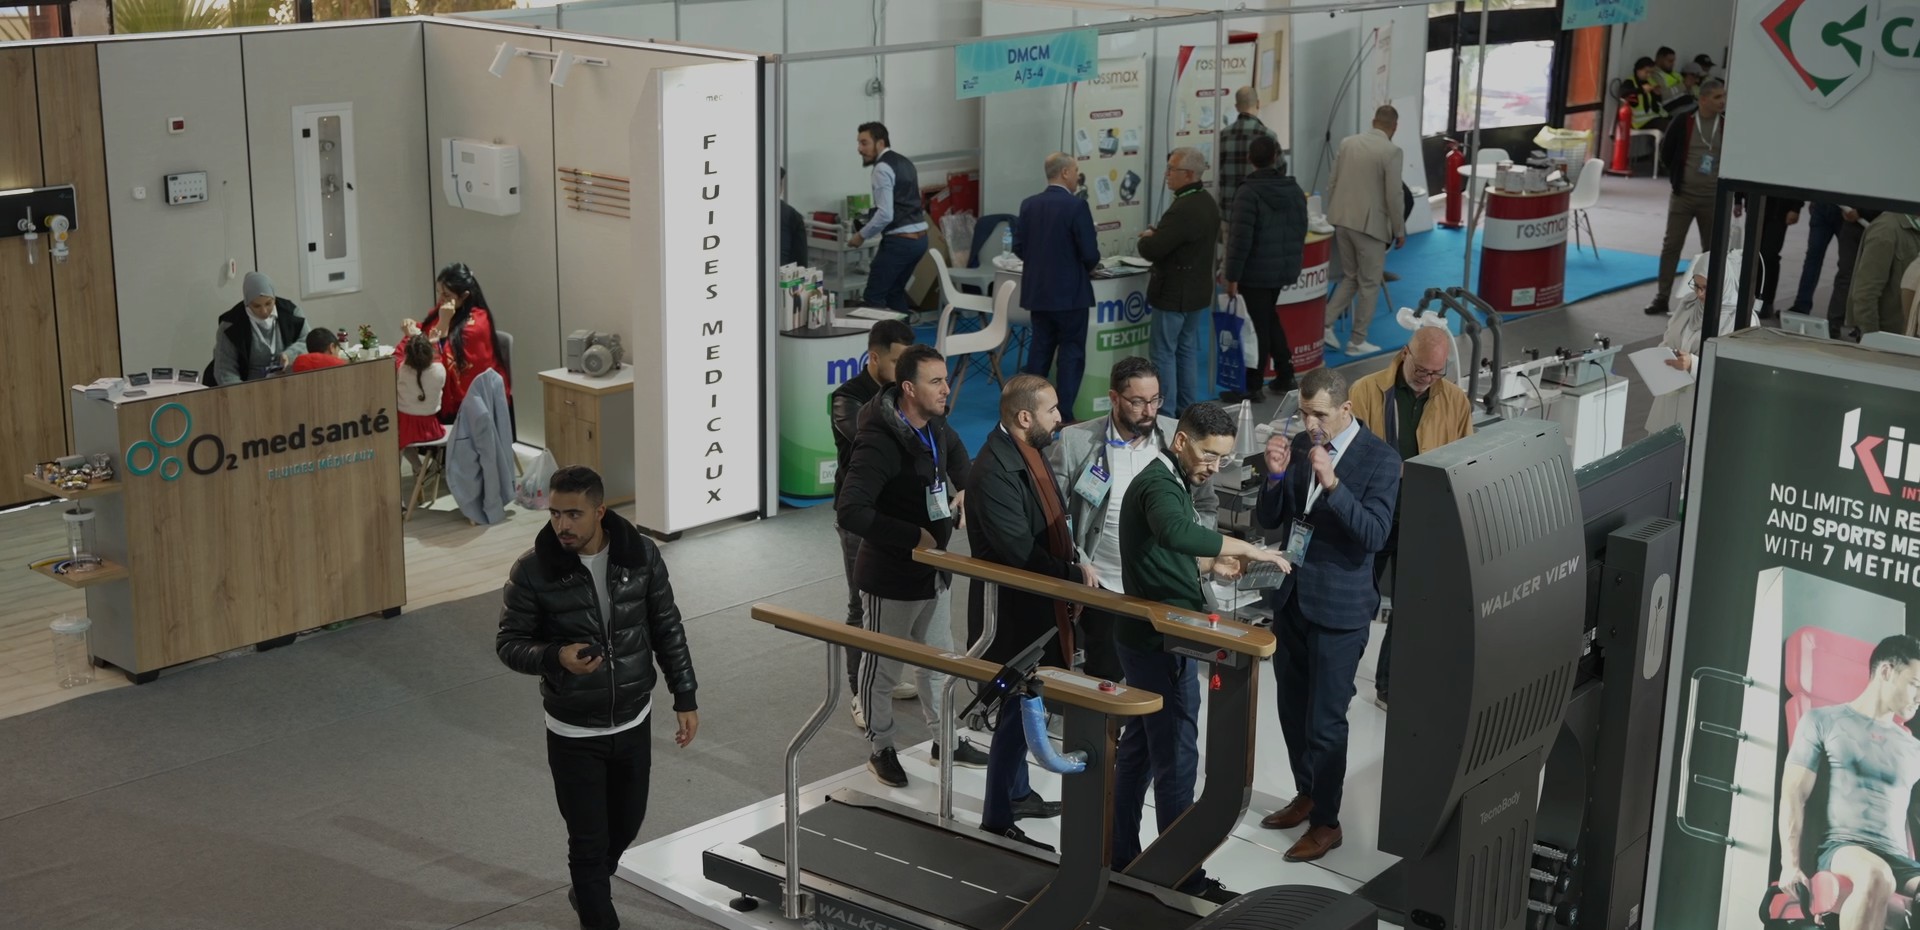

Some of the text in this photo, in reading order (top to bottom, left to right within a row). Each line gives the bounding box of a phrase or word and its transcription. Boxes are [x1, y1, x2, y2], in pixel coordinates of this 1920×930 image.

[1007, 44, 1051, 64] DMCM
[1881, 17, 1920, 58] C
[1014, 67, 1044, 83] A/3-4
[1195, 57, 1247, 71] rosmax
[1516, 217, 1567, 239] rossma
[702, 134, 724, 504] FLUIDES MEDICAUX
[241, 424, 306, 460] med
[311, 408, 390, 446] santé
[268, 449, 376, 480] FLUIDES MÉDICAUX
[1770, 482, 1797, 505] NO
[1801, 489, 1864, 520] LIMITS
[1869, 503, 1890, 526] IN
[1766, 508, 1808, 533] AND
[1812, 517, 1887, 550] SPORTS
[1764, 533, 1813, 562] WITH
[1822, 544, 1835, 566] 7
[1481, 555, 1580, 618] WALKER VIEW
